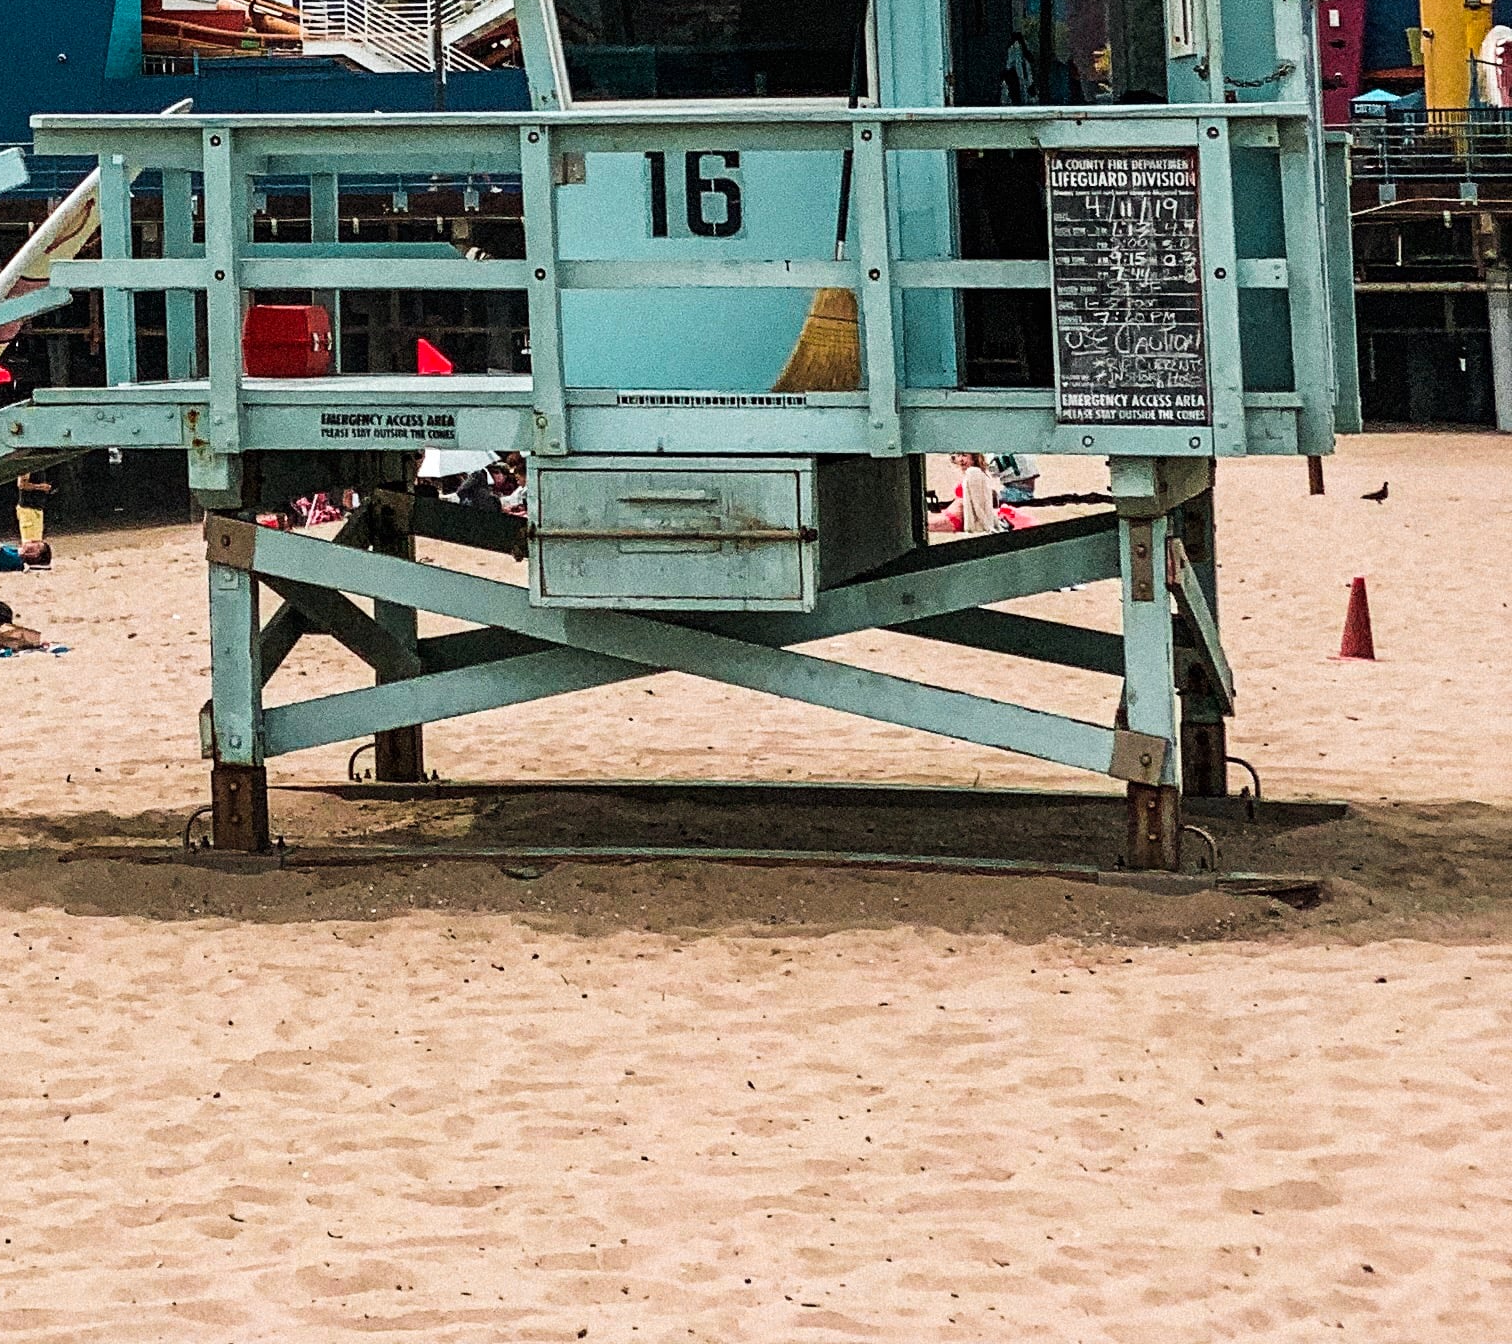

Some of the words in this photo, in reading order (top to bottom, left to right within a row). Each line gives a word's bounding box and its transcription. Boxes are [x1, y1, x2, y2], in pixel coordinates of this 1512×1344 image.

[1052, 160, 1063, 170] LA
[1065, 160, 1104, 170] COUNTY
[1108, 160, 1129, 170] FIRE
[1052, 172, 1128, 187] LIFEGUARD
[1132, 172, 1196, 187] DIVISION
[644, 150, 742, 238] 16
[1114, 323, 1201, 354] CAUTION
[1062, 394, 1128, 407] EMERGENCY
[1131, 394, 1172, 407] ACCESS
[1175, 394, 1205, 407] AREA
[321, 413, 383, 426] EMERGENCY
[386, 414, 424, 427] ACCESS
[427, 414, 455, 427] AREA
[1095, 409, 1117, 420] STAY
[1119, 409, 1156, 420] OUTSIDE
[1158, 409, 1174, 420] THE
[411, 429, 425, 440] THE
